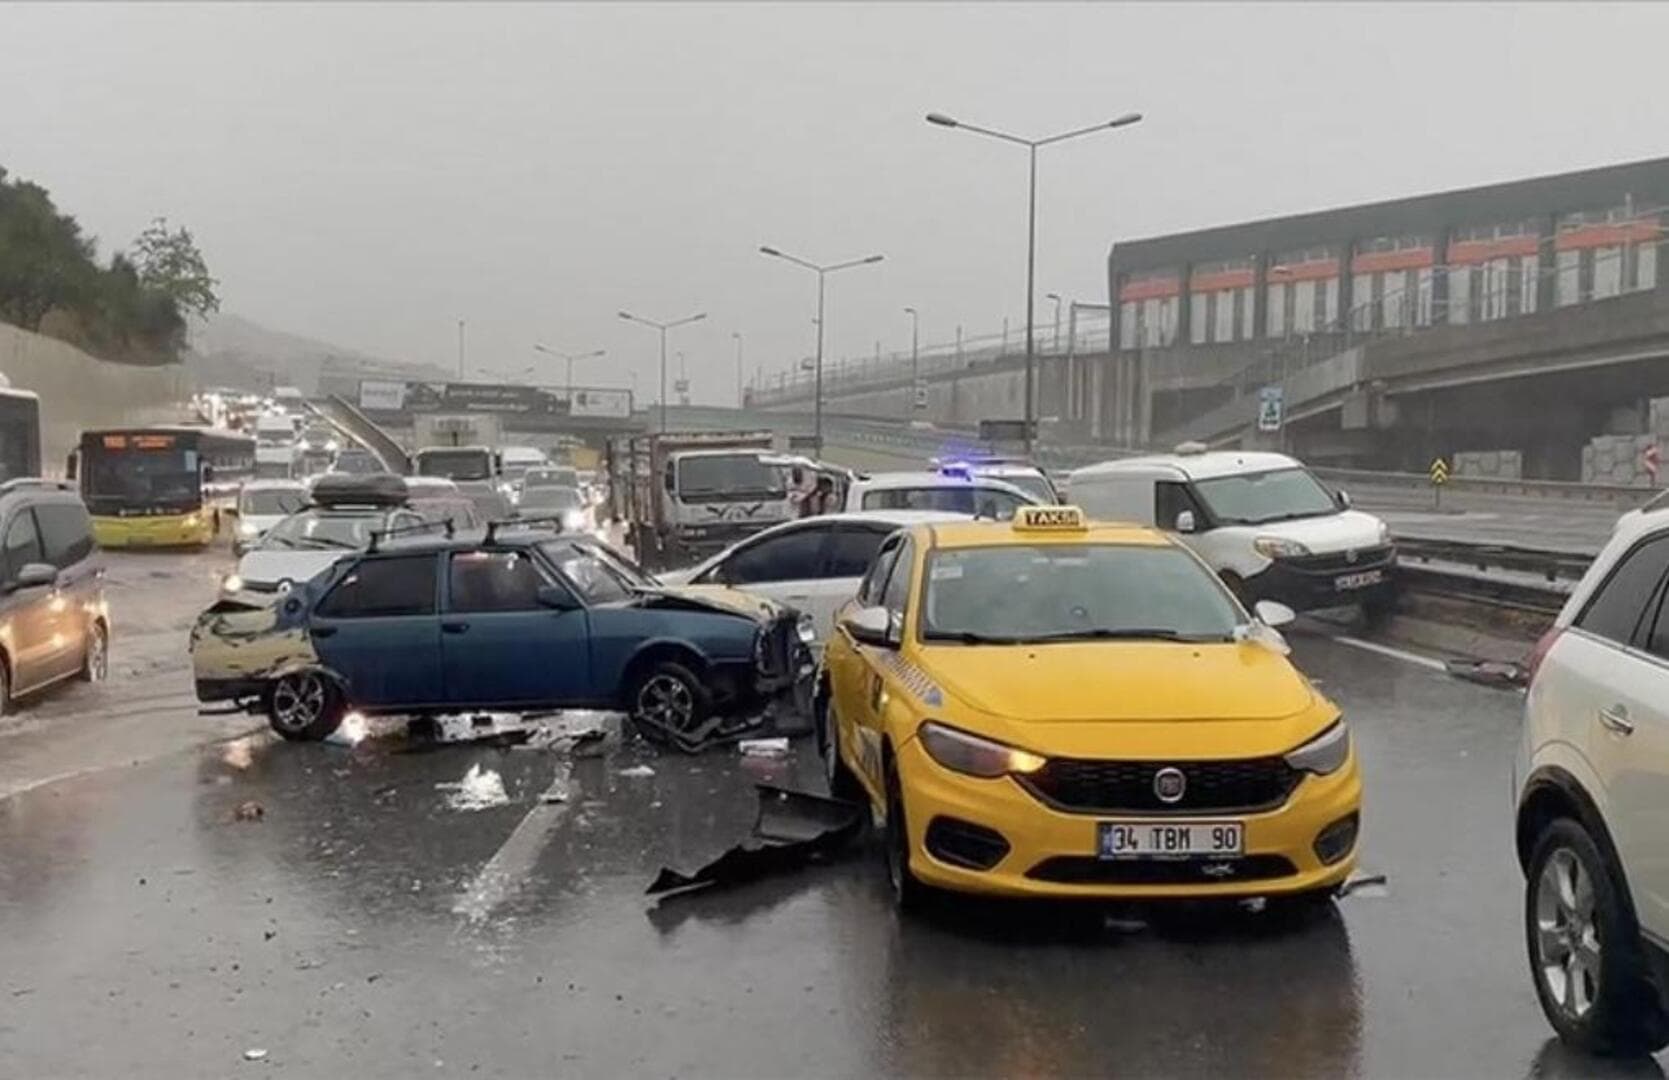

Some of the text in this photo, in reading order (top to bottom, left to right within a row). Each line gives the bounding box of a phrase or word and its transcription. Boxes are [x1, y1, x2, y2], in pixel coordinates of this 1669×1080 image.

[1114, 828, 1237, 850] 34 TBM 90
